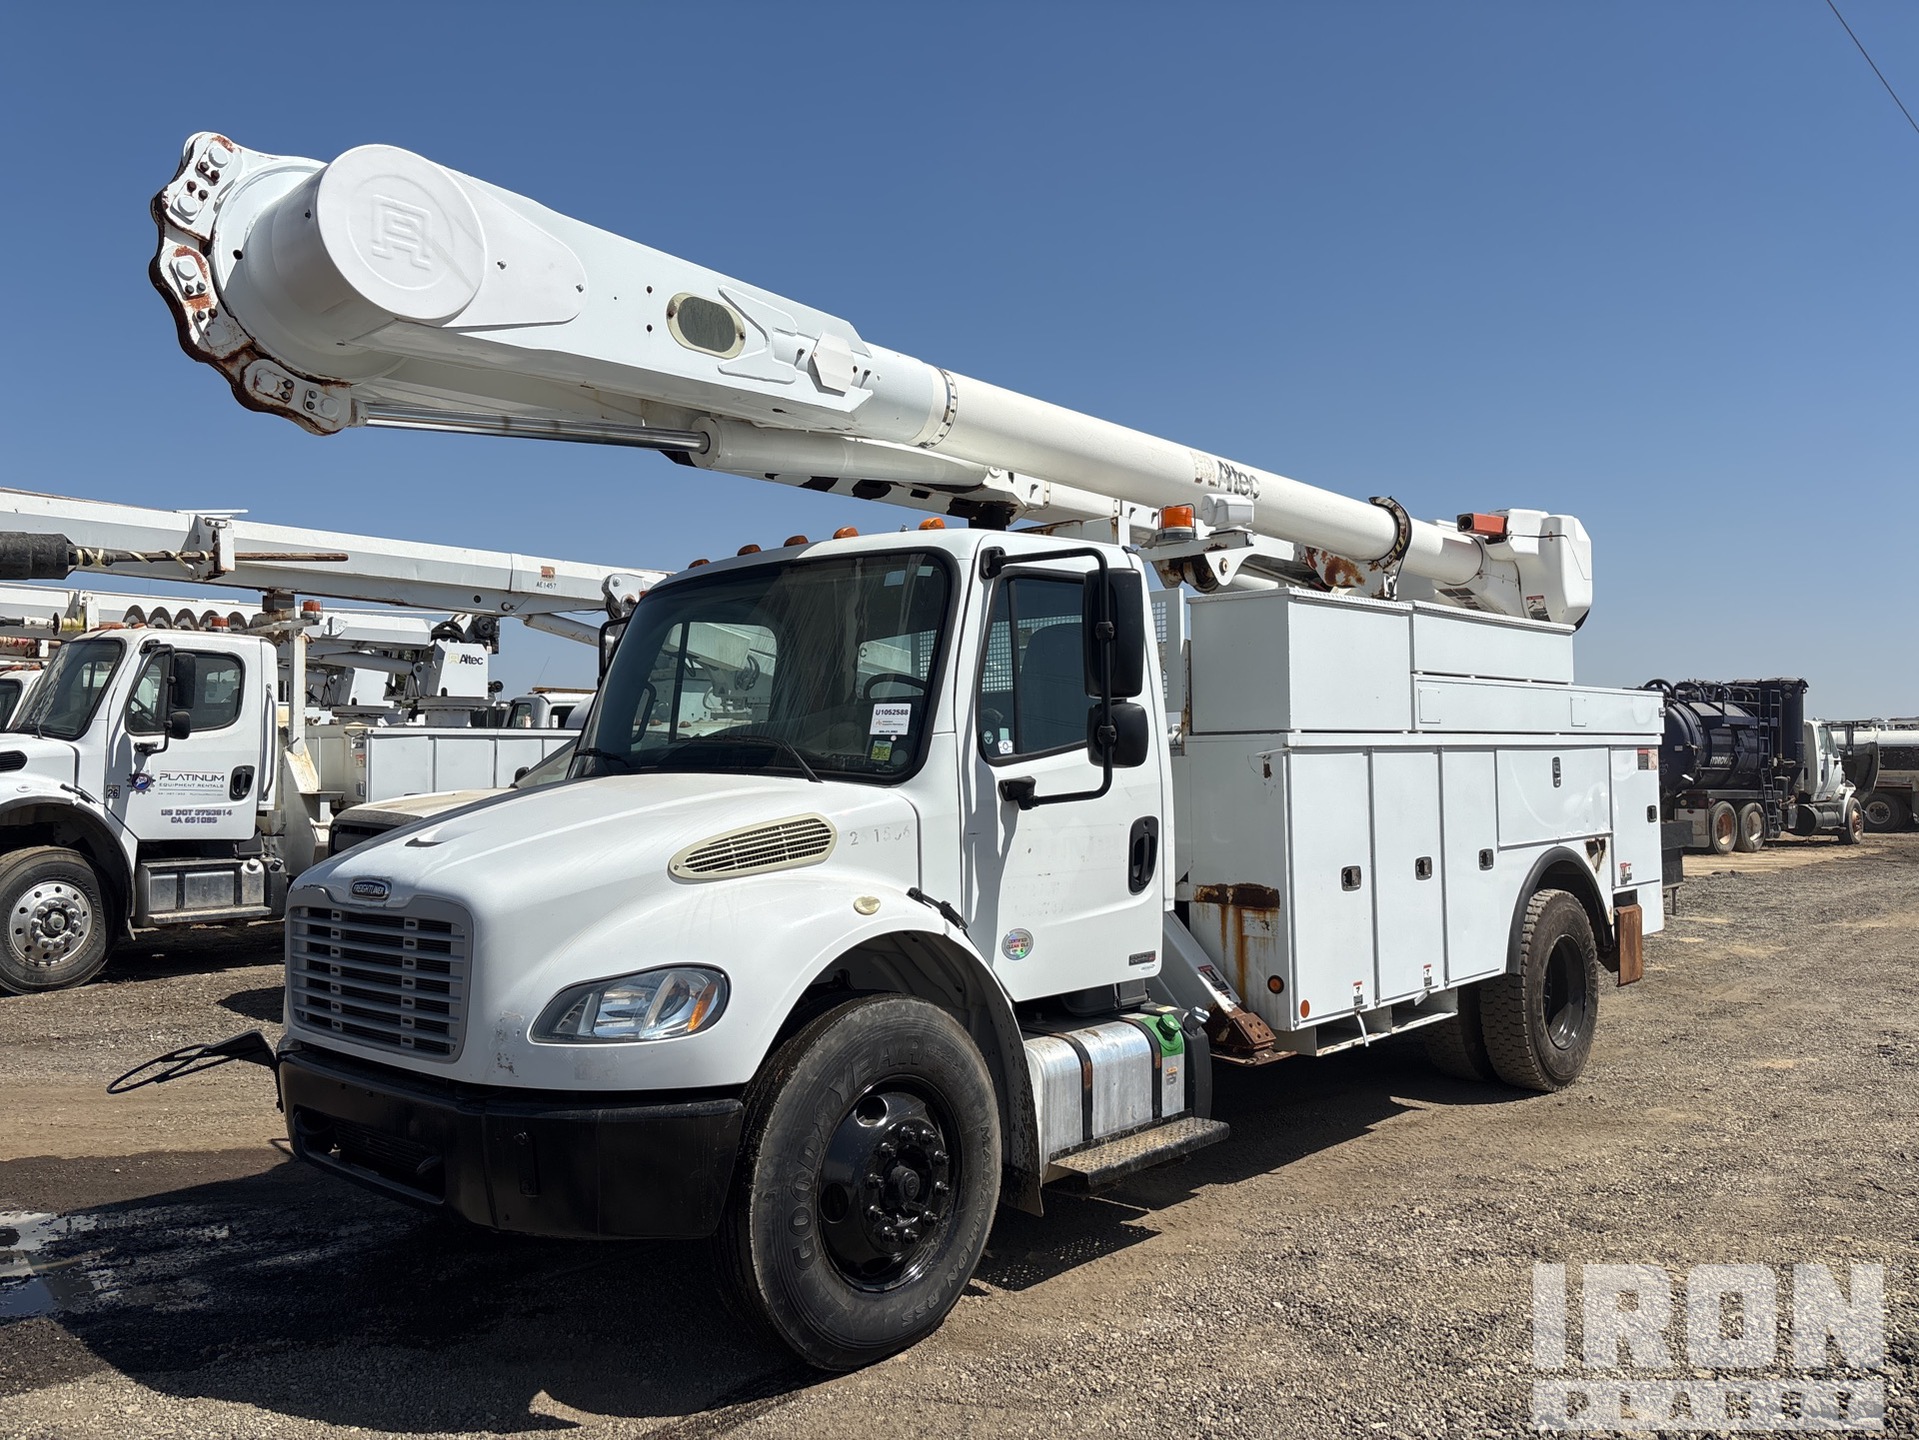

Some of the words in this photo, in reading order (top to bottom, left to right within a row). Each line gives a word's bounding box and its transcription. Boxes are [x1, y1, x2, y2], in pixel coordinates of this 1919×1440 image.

[459, 654, 484, 665] Altec
[159, 772, 225, 782] PLATINUM
[107, 788, 119, 798] 26
[788, 1033, 925, 1271] GOODYEAR
